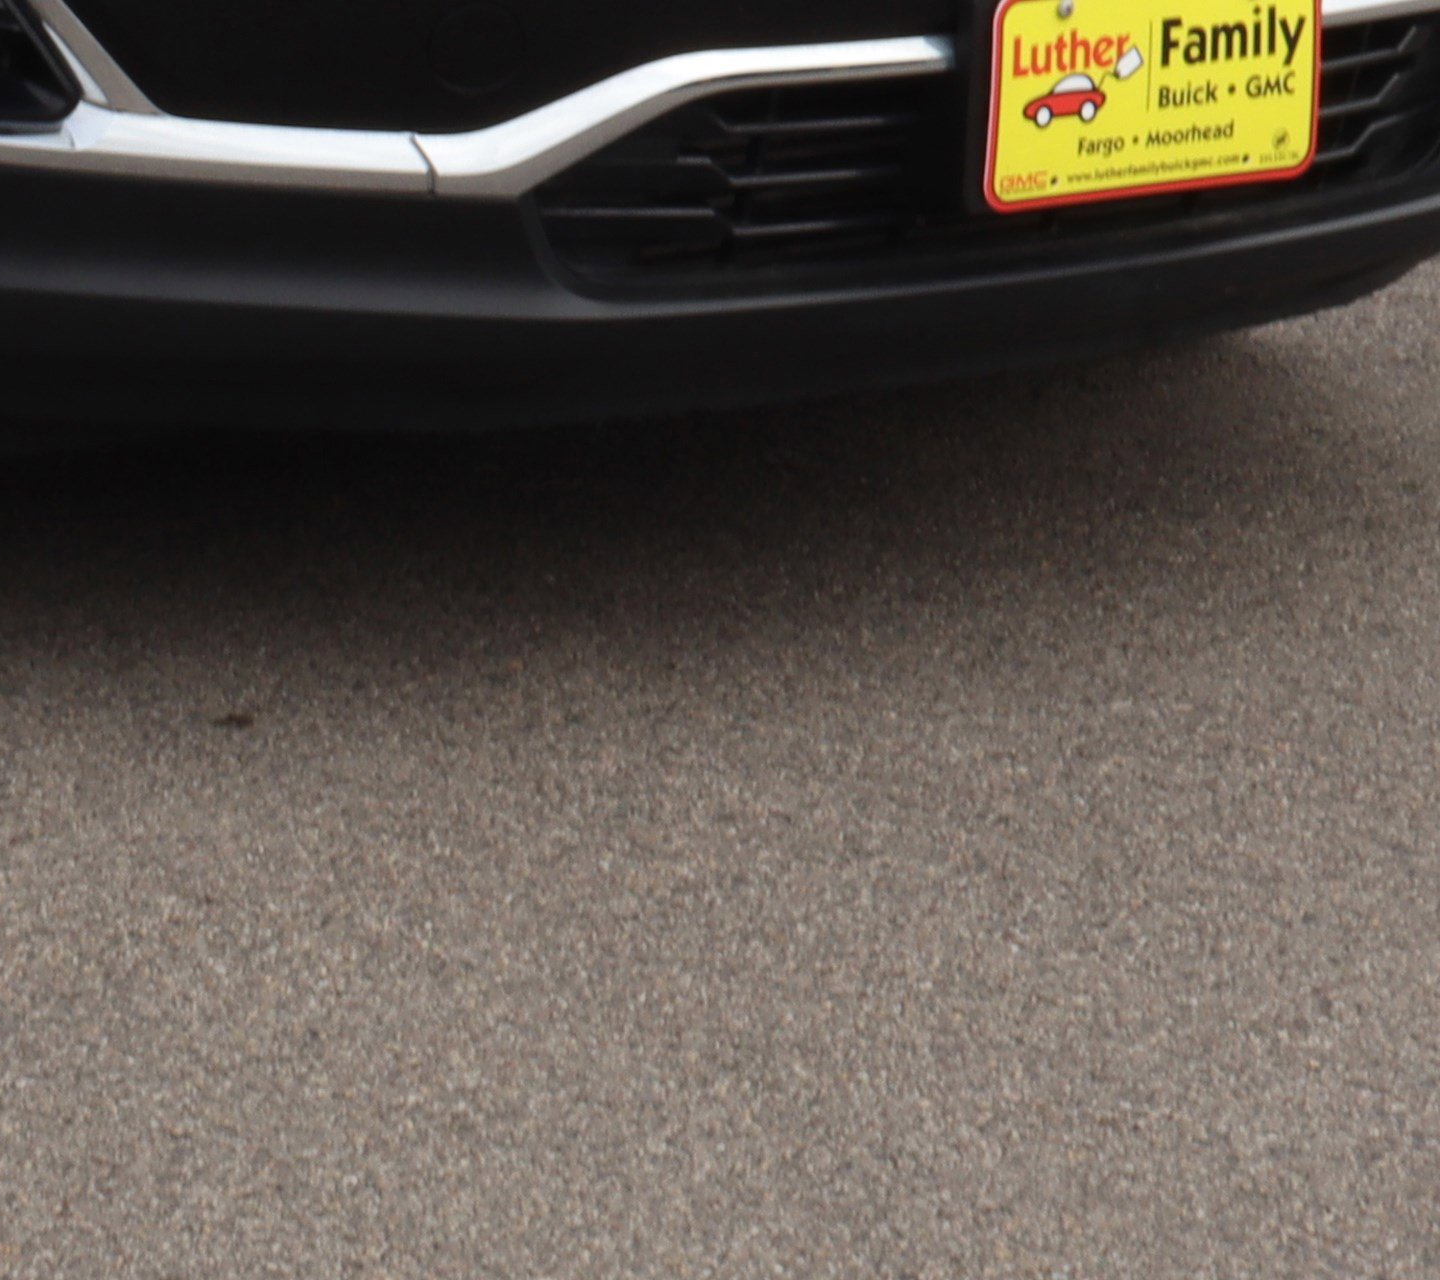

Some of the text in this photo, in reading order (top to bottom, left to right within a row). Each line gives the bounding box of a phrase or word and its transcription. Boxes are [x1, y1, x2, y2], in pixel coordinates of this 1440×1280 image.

[1012, 28, 1131, 78] Luther
[1160, 3, 1306, 68] Family
[1158, 71, 1296, 109] Buick GMC
[1077, 120, 1234, 158] Fargo Moorhead
